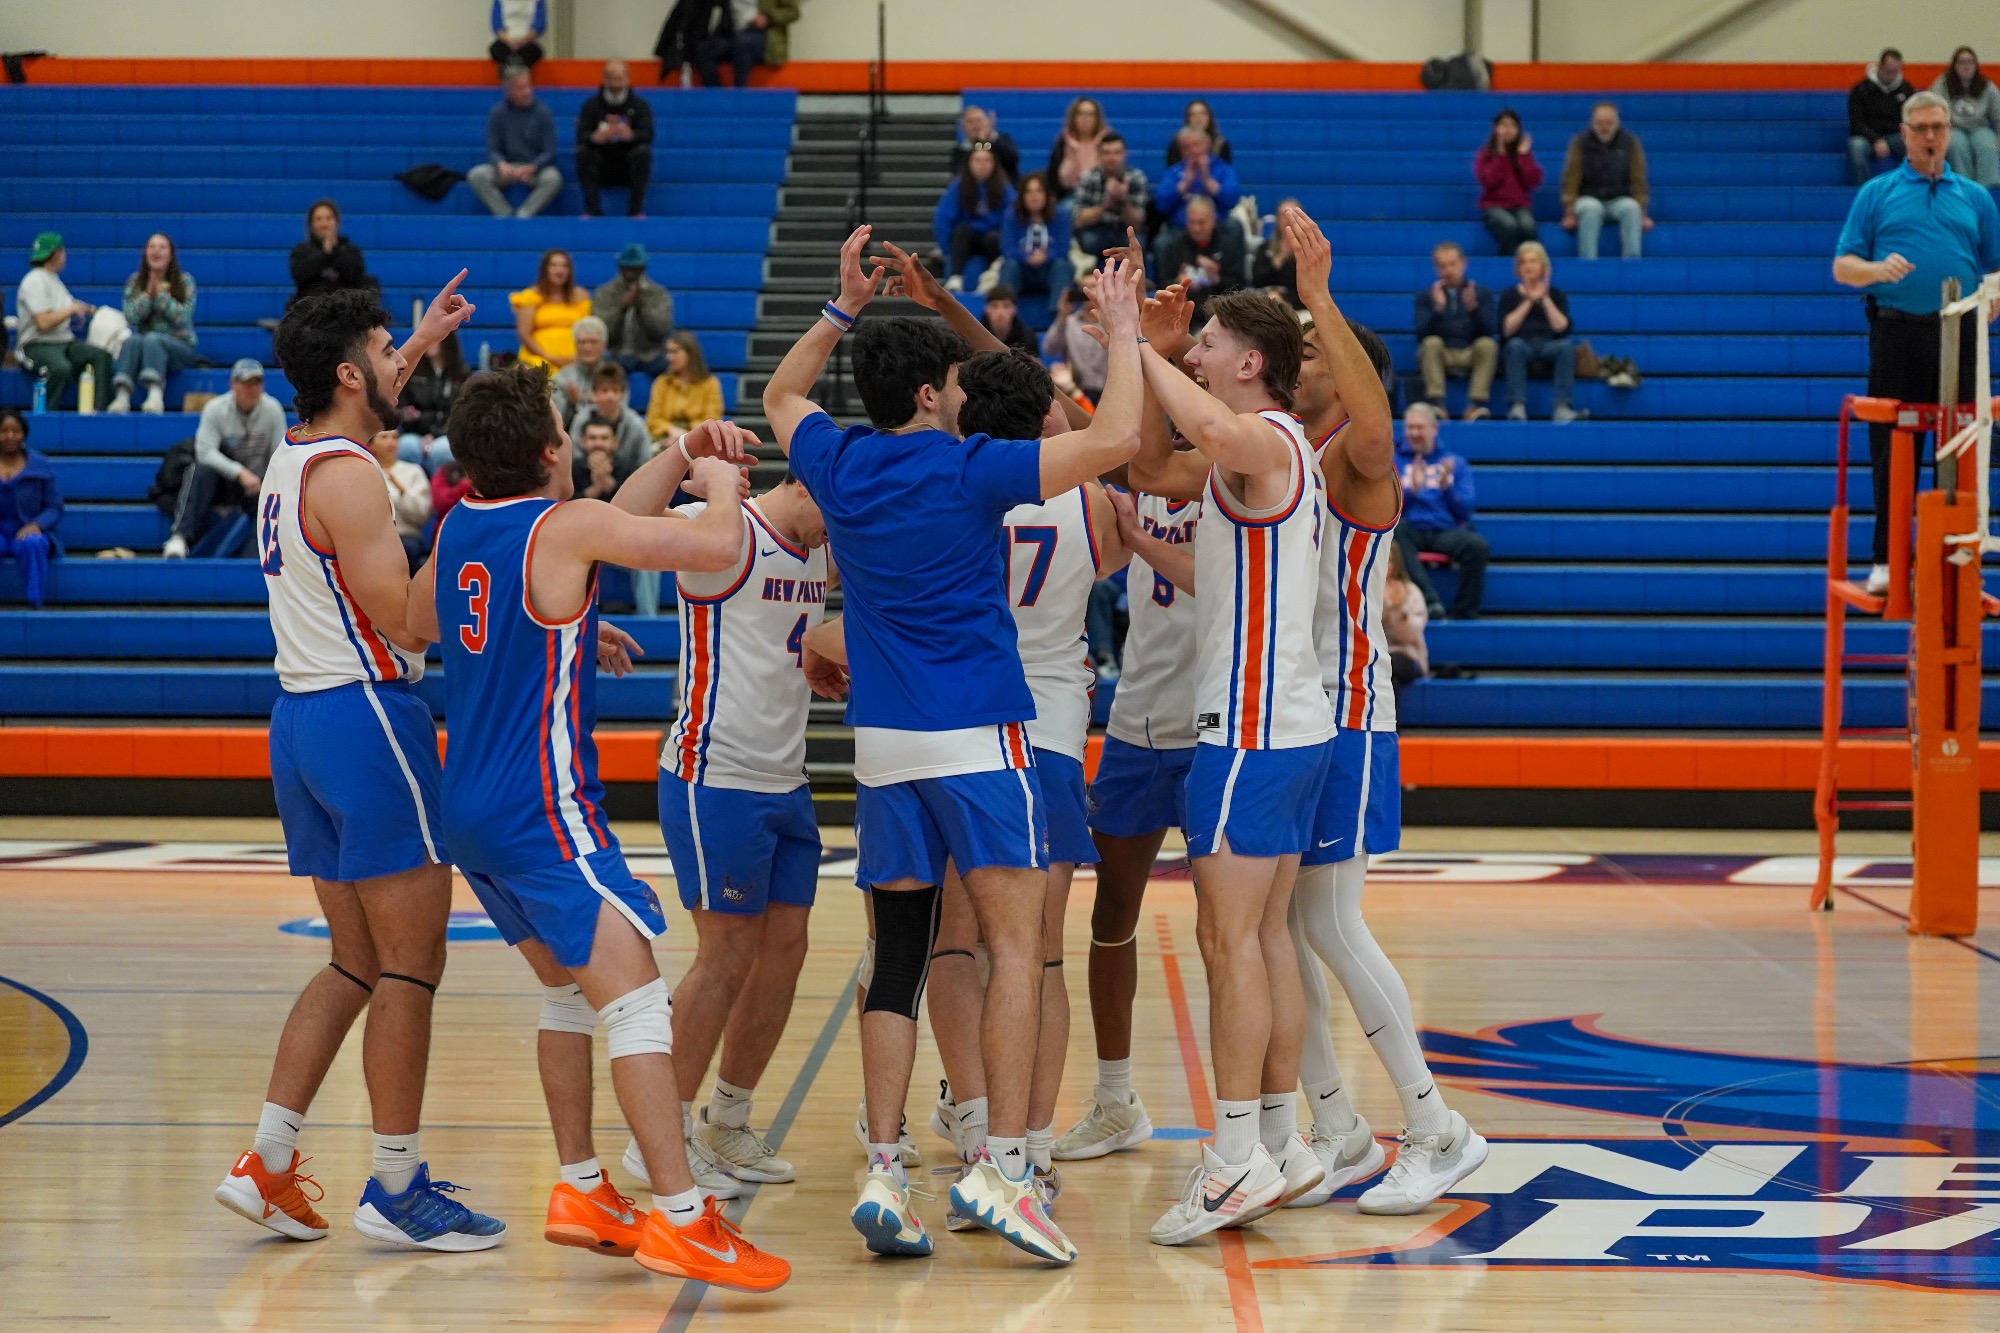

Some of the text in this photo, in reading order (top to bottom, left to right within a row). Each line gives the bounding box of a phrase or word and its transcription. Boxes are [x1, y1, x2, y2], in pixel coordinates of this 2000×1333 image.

[458, 561, 491, 654] 3
[761, 577, 796, 603] NEW
[786, 613, 808, 668] 4
[1645, 1253, 1712, 1262] TM
